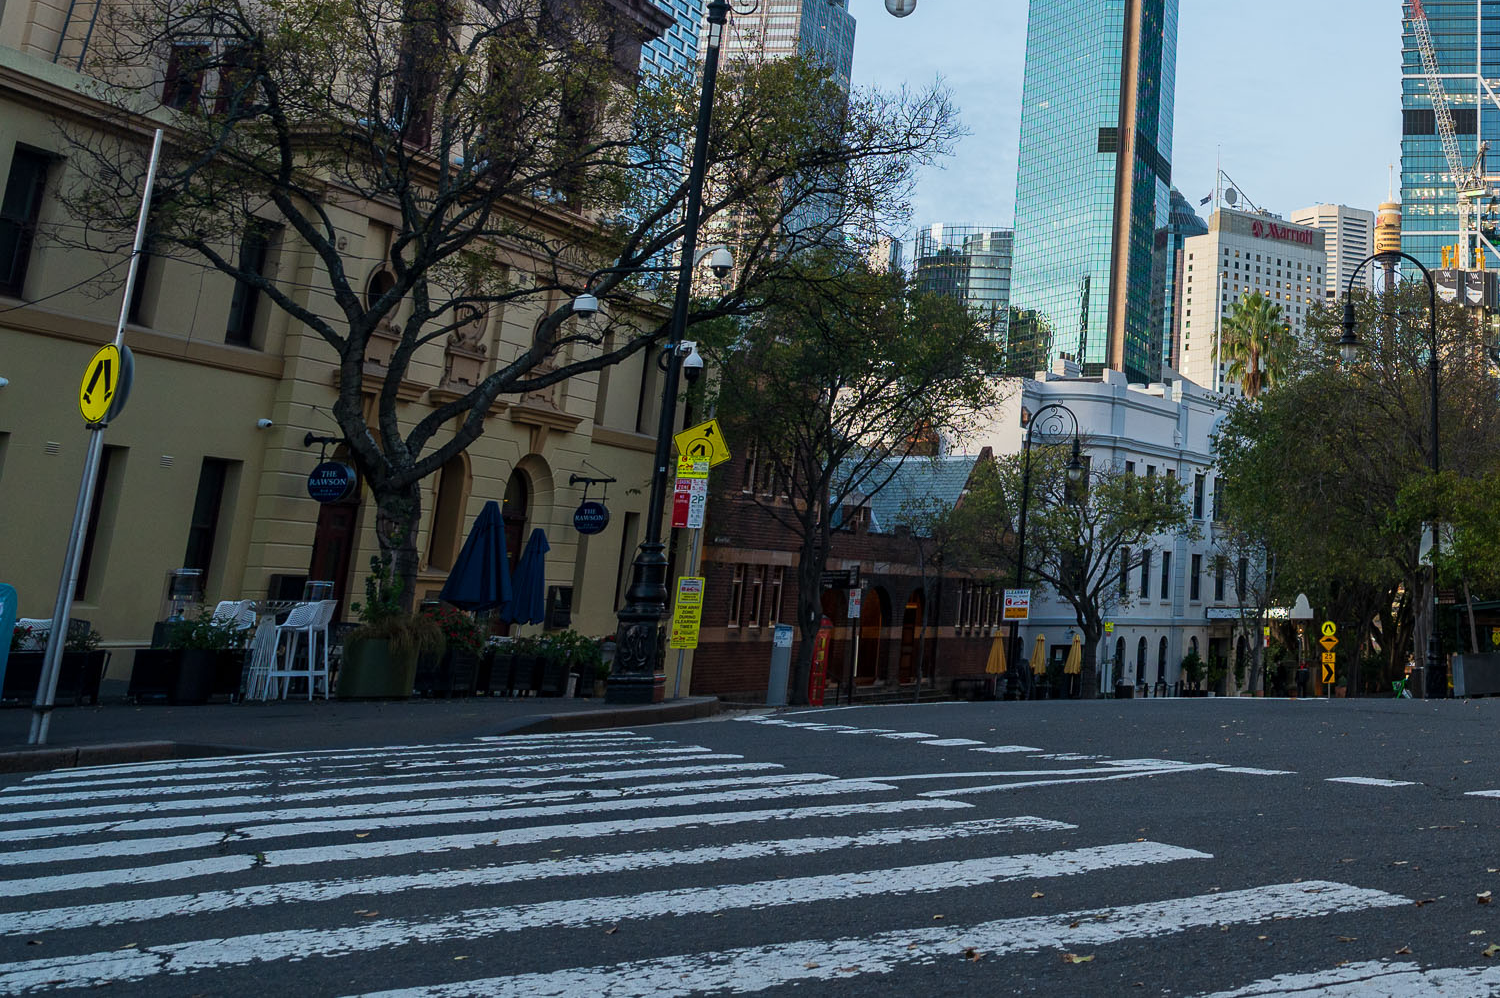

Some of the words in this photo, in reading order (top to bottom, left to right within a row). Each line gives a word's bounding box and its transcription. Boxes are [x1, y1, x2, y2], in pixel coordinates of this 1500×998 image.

[1264, 222, 1313, 245] Marriott
[321, 470, 337, 478] THE
[310, 478, 347, 486] RAWSON
[691, 495, 704, 504] 2P
